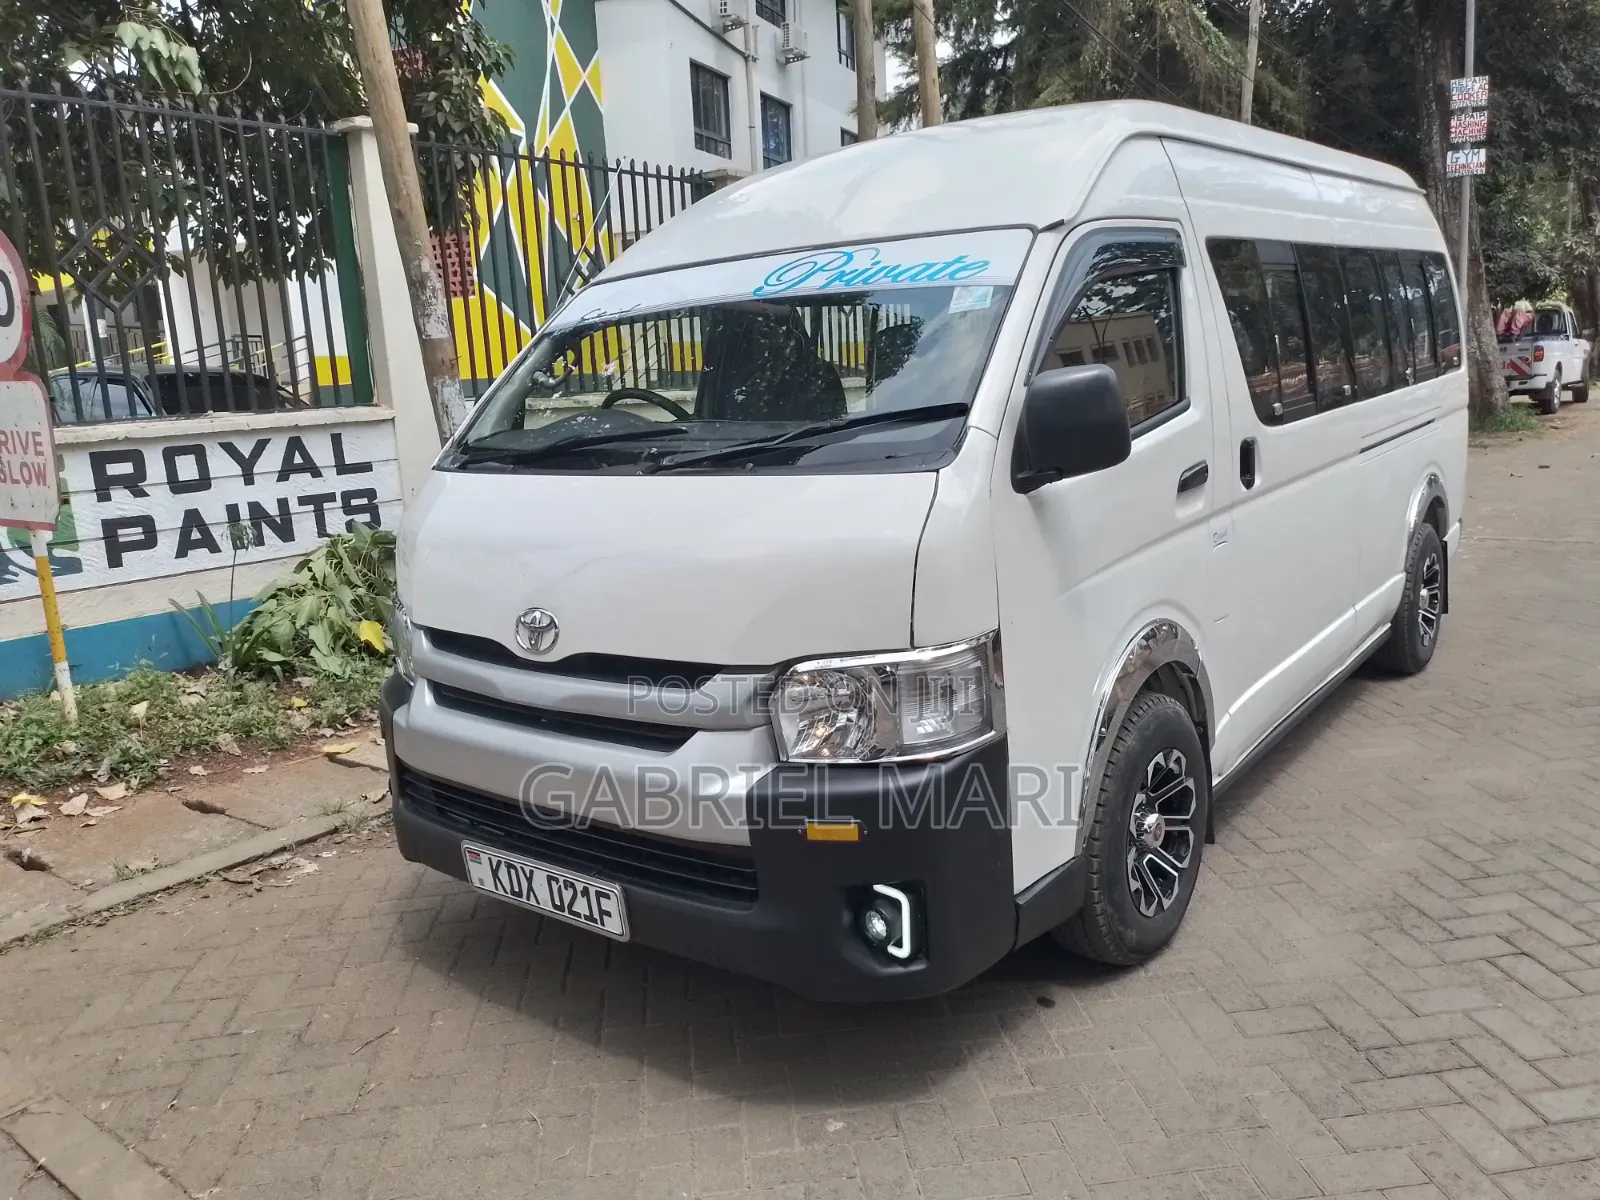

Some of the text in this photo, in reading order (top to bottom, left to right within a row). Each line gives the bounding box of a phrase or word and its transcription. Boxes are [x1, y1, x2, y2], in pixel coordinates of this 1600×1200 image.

[1451, 77, 1488, 87] REPAIR
[1451, 91, 1488, 101] COOKER
[1450, 120, 1487, 129] WASHING
[1451, 149, 1480, 163] GYM
[753, 247, 990, 297] Private
[0, 460, 47, 486] SLOW
[89, 432, 374, 503] ROYAL
[101, 487, 382, 569] PAINTS
[488, 856, 613, 927] KDX 021F
